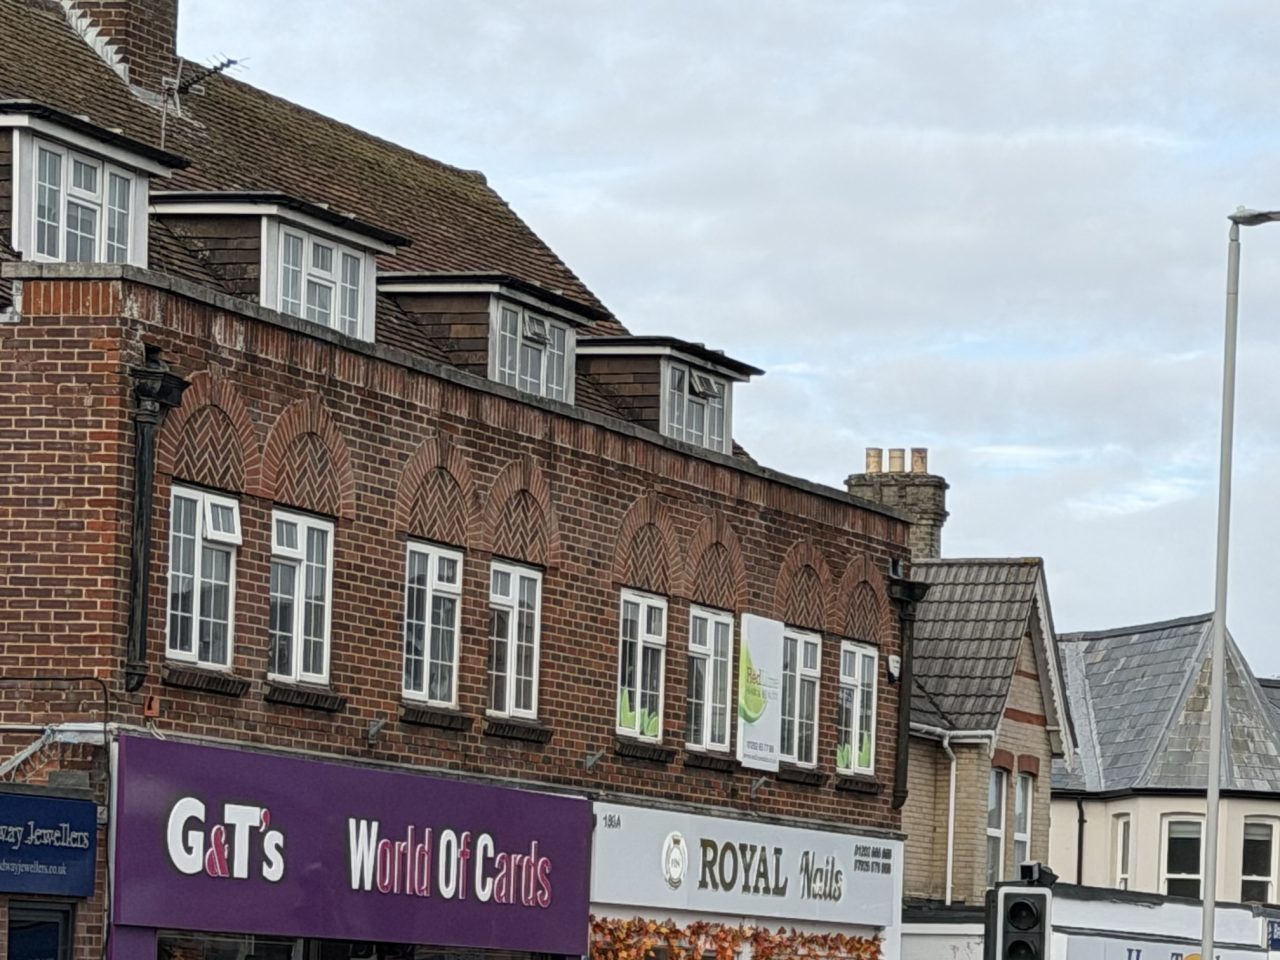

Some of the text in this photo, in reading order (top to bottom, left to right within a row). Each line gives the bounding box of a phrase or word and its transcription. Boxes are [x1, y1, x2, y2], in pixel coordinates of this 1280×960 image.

[24, 821, 89, 849] Jewellers
[167, 797, 284, 882] G&T's
[349, 818, 552, 908] World Of Cards
[698, 838, 843, 902] ROYAL Nails
